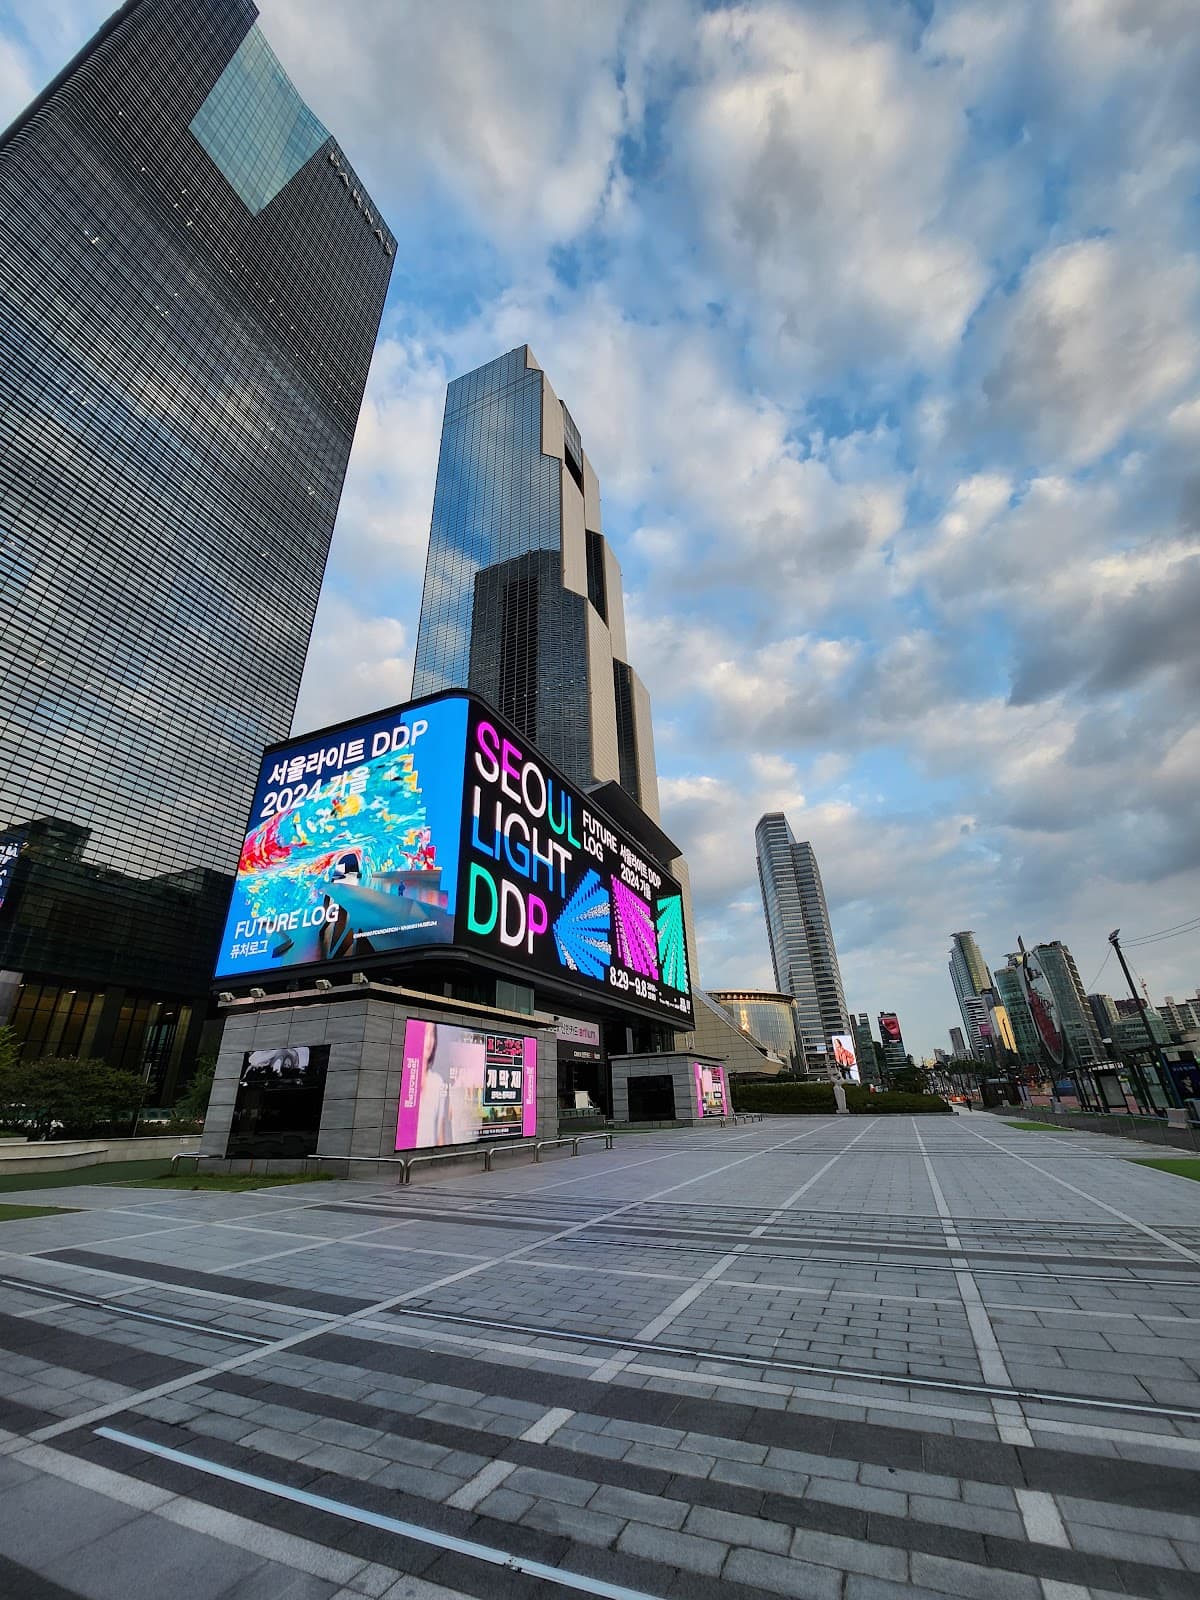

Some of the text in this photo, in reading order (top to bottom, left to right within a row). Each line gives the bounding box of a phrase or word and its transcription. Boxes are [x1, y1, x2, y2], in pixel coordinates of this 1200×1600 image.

[267, 719, 429, 785] 서울라이트 DDP
[260, 766, 370, 818] 2024 가을
[474, 721, 581, 849] SEOUL
[472, 785, 572, 899] LIGHT
[582, 809, 618, 854] FUTURE
[583, 832, 604, 863] LOG
[620, 863, 640, 891] 2024
[648, 868, 662, 889] DDP
[234, 904, 340, 940] FUTURE LOG
[466, 862, 548, 956] DDP
[229, 939, 268, 959] 퓨처로그
